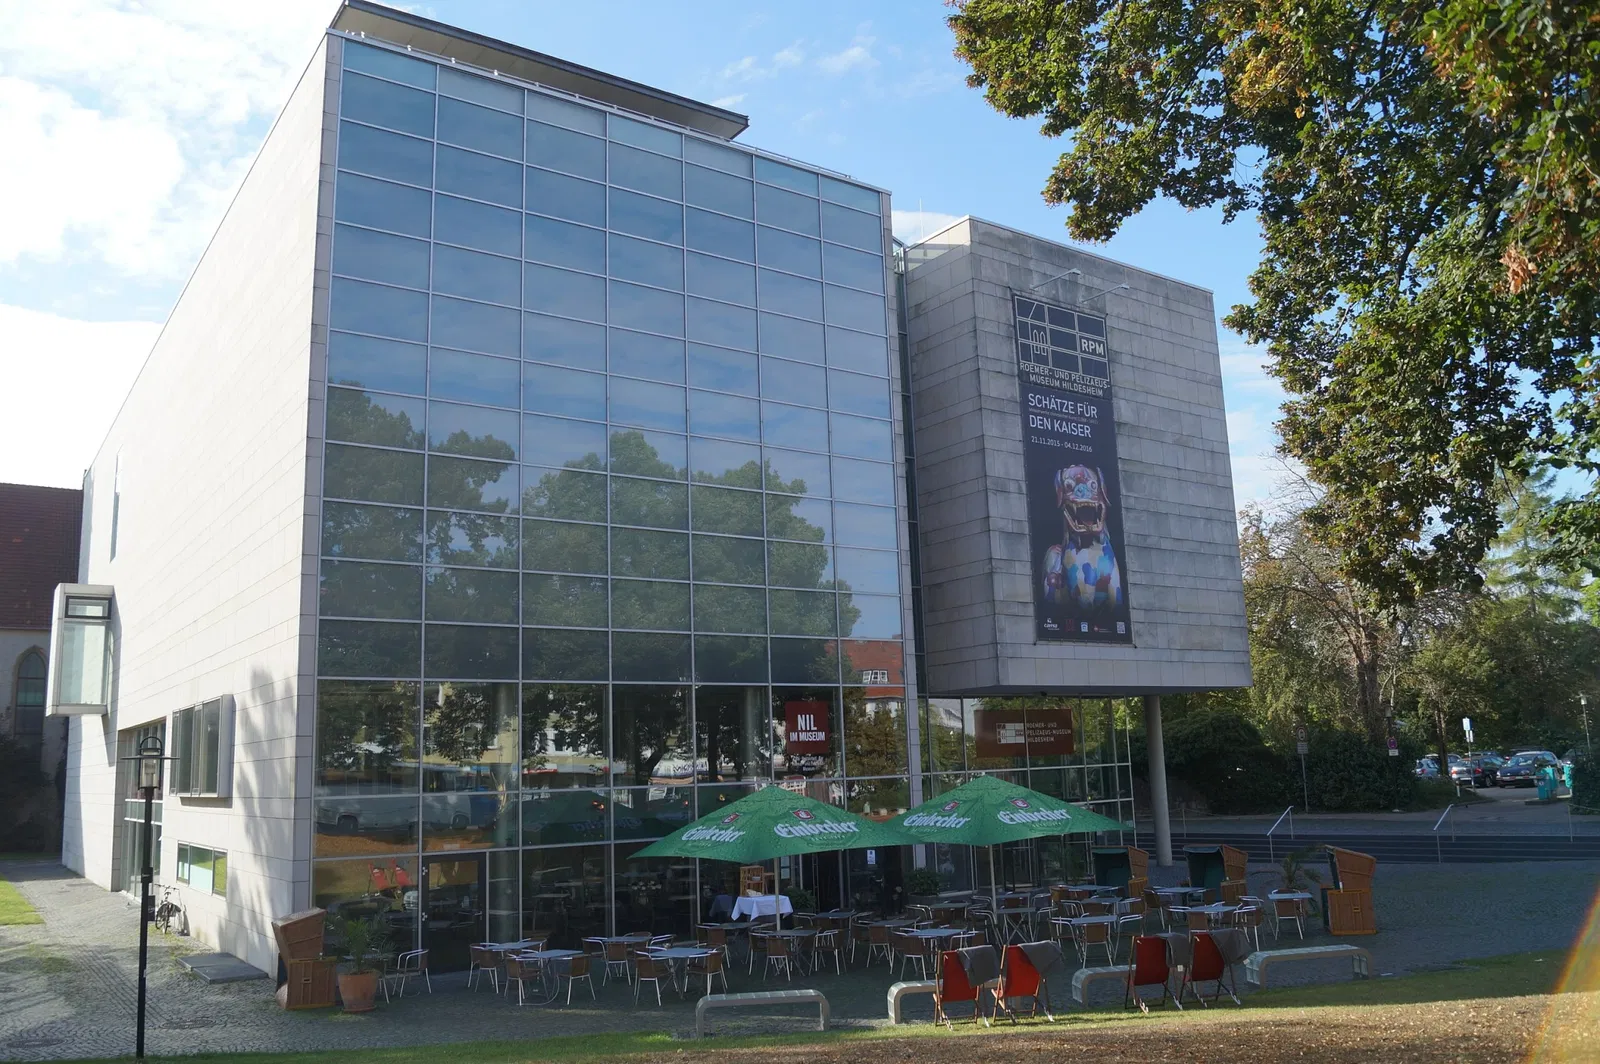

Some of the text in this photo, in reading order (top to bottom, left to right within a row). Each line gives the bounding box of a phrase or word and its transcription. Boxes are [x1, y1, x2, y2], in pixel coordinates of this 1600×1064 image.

[1081, 339, 1104, 356] RPM
[1019, 363, 1111, 389] ROEMER- UND PELIZAEUS-
[1029, 374, 1103, 397] MUSEUM HILDESHEIM
[1028, 393, 1075, 414] SCHÄTZE
[1077, 402, 1098, 419] FÜR
[1029, 415, 1051, 431] DEN
[1054, 420, 1092, 438] KAISER
[797, 714, 817, 731] NIL
[789, 731, 825, 742] IM MUSEUM
